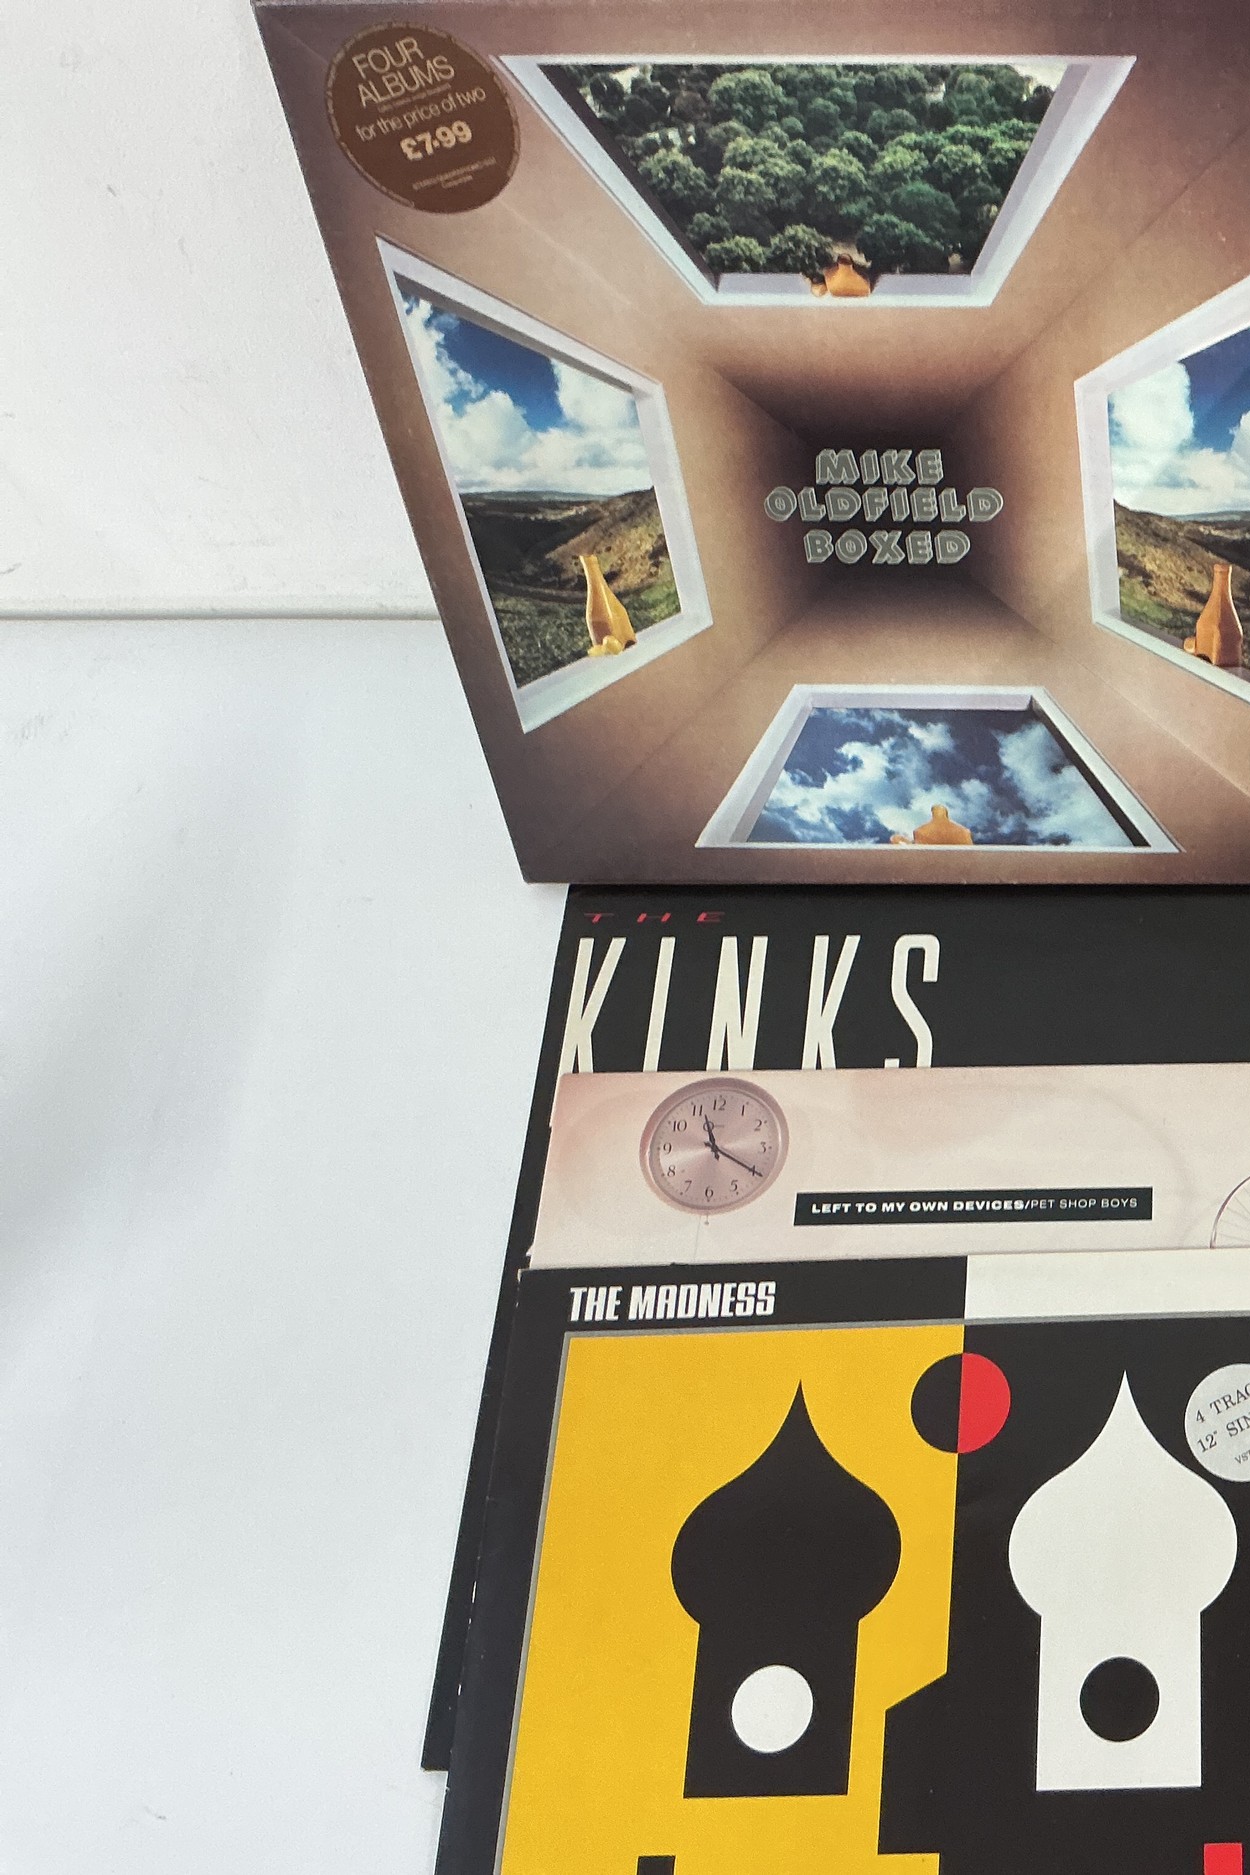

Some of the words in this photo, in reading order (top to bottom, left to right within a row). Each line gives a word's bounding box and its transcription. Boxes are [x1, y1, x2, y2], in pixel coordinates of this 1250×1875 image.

[352, 37, 424, 79] FOUR
[357, 55, 455, 107] ALBUMS
[355, 123, 376, 142] for
[377, 117, 402, 136] the
[403, 102, 441, 129] price
[441, 96, 457, 114] of
[457, 87, 486, 108] two
[815, 448, 944, 485] MIKE
[763, 486, 1004, 522] OLDFIELD
[803, 529, 971, 564] BOXED
[584, 911, 726, 924] THE
[557, 934, 941, 1075] KINKS
[692, 1104, 703, 1116] 11
[713, 1099, 726, 1111] 12
[672, 1120, 687, 1132] 10
[754, 1119, 762, 1131] 2
[663, 1142, 672, 1154] 9
[760, 1142, 767, 1153] 3
[667, 1165, 676, 1177] 8
[684, 1180, 692, 1192] 7
[705, 1186, 714, 1198] 6
[730, 1180, 738, 1192] 5
[811, 1203, 851, 1214] LEFT
[855, 1202, 877, 1213] TO
[881, 1201, 906, 1213] MY
[909, 1200, 948, 1211] OWN
[1059, 1199, 1096, 1209] SHOP
[1101, 1198, 1138, 1209] BOYS
[570, 1286, 623, 1322] THE
[628, 1281, 777, 1321] MADNESS
[1195, 1409, 1206, 1424] 4
[1197, 1430, 1218, 1453] 12"
